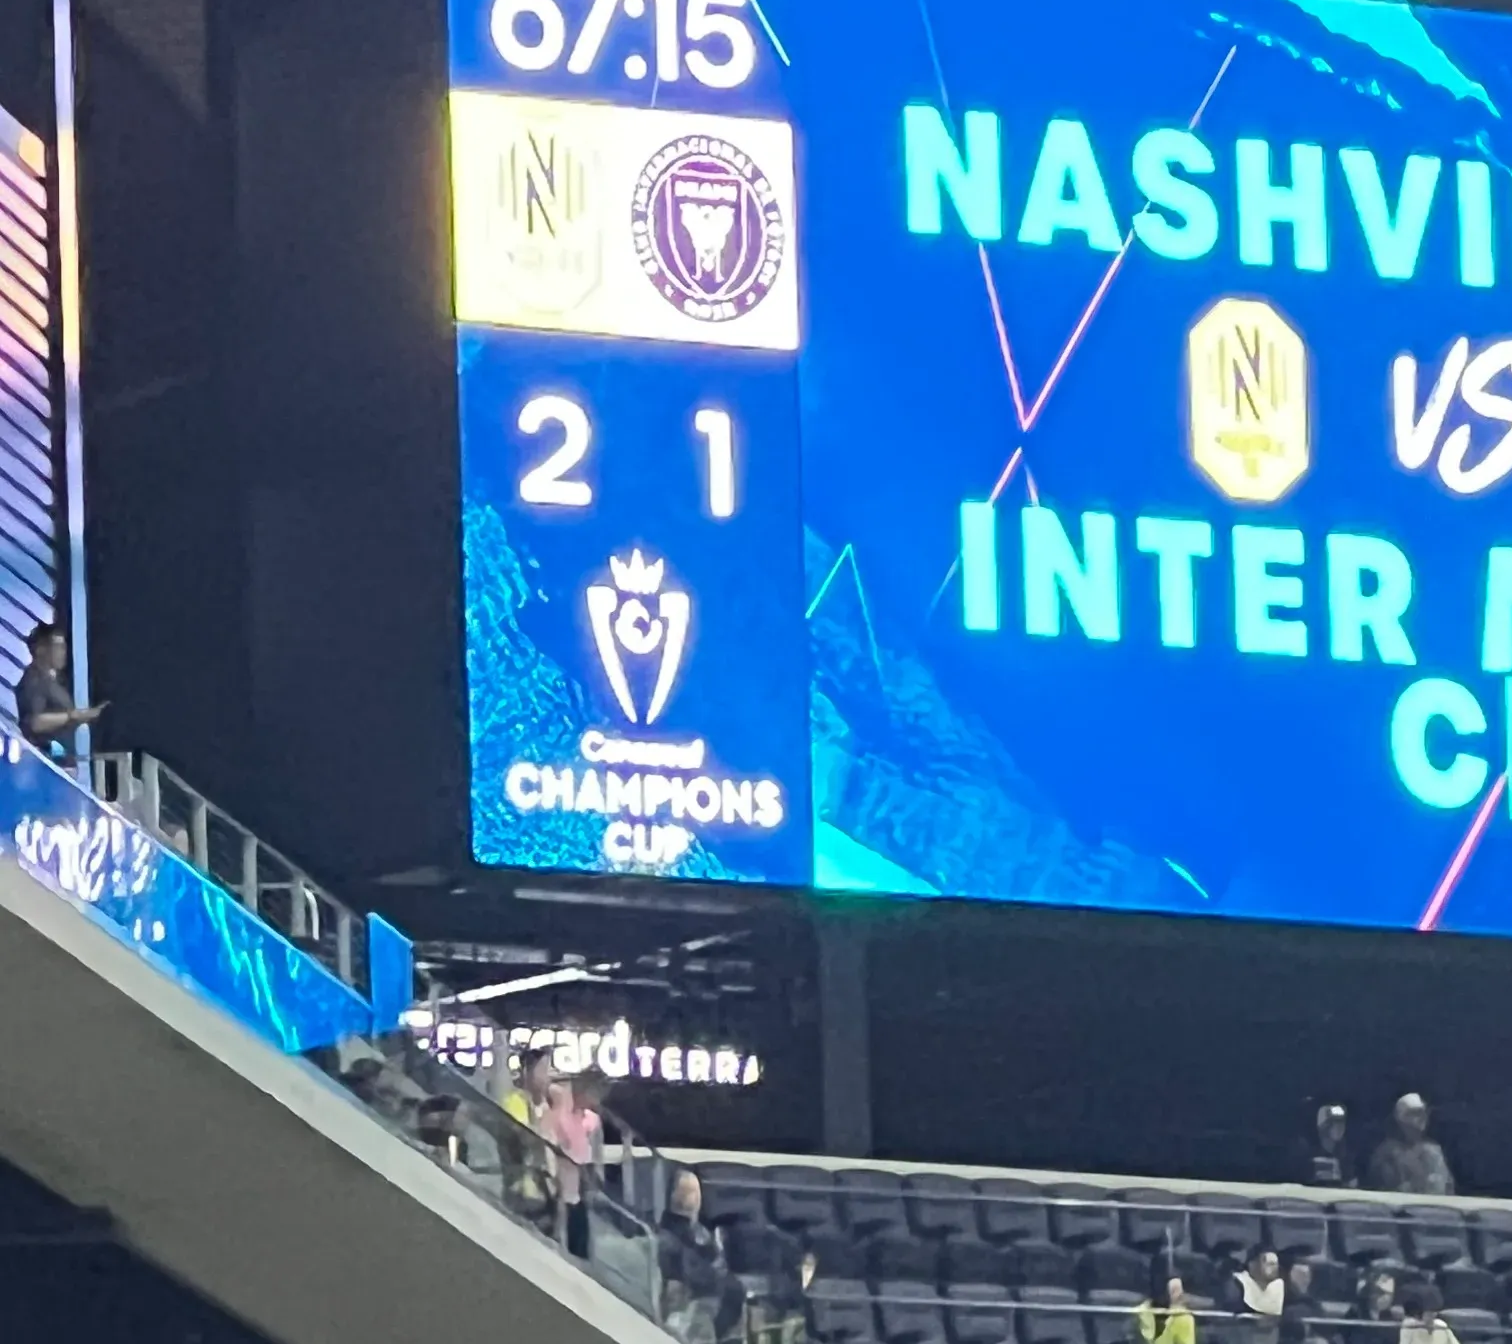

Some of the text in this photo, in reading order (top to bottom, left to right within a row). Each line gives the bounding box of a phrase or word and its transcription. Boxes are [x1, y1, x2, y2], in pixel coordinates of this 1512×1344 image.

[518, 395, 592, 506] 2
[695, 409, 735, 517] 1
[958, 499, 1417, 667] INTER
[505, 761, 784, 829] CHAMPIONS
[603, 820, 691, 864] CUP
